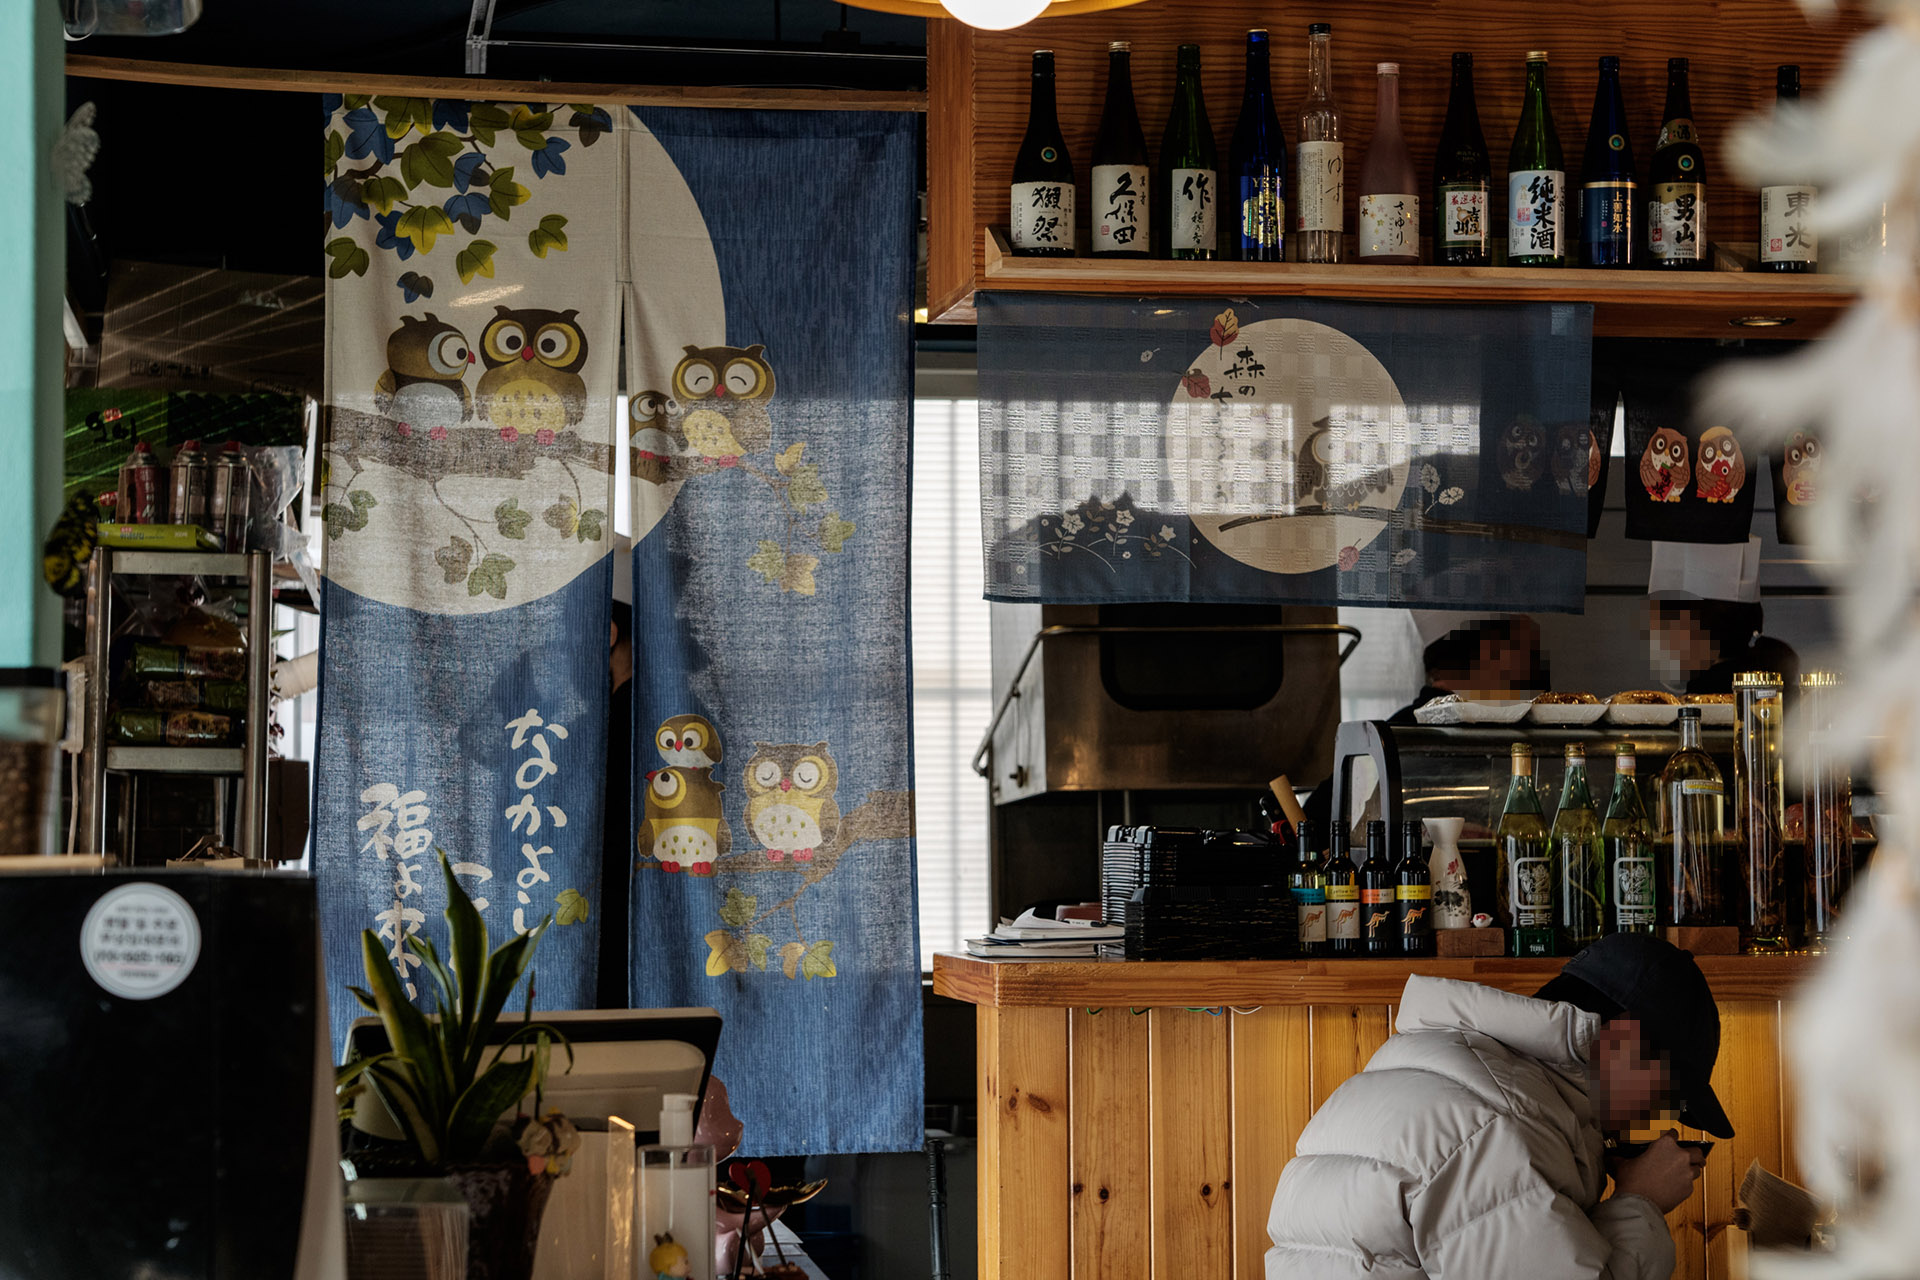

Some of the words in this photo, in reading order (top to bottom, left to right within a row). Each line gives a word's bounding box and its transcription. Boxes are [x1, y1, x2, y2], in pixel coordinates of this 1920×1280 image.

[1105, 171, 1137, 245] 久保田
[1183, 173, 1211, 210] 作
[1527, 175, 1556, 251] 純米酒
[1612, 191, 1624, 234] 上善如水
[1393, 200, 1405, 247] さゆり
[1674, 193, 1697, 244] 男山
[1784, 191, 1812, 249] 東光
[1223, 345, 1266, 397] 森の
[505, 708, 567, 938] なかよし
